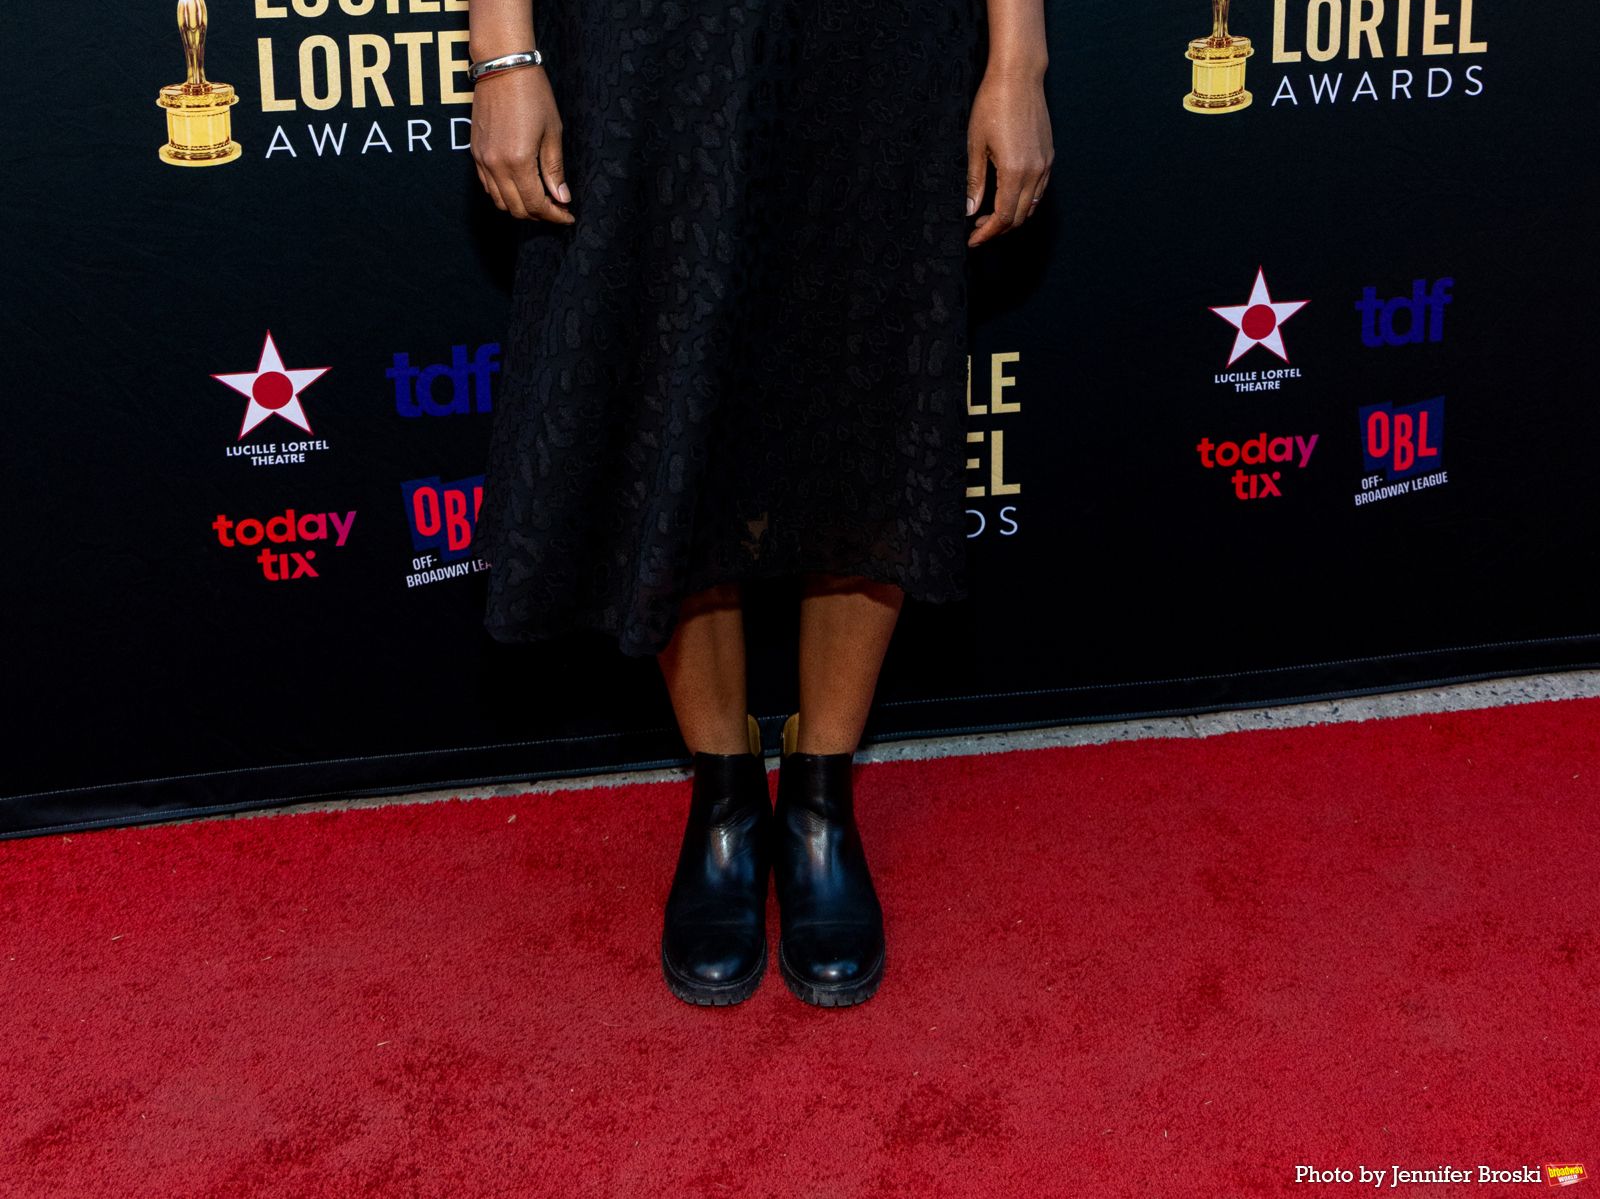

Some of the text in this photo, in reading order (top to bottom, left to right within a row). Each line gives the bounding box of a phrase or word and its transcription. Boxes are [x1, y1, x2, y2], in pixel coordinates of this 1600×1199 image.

[258, 31, 474, 111] LORTE
[1272, 66, 1482, 106] AWARDS
[265, 118, 472, 158] AWARD
[1355, 277, 1454, 347] tdf
[386, 344, 500, 417] tdf
[1214, 369, 1301, 384] LUCILLE LORTEL
[1235, 380, 1281, 393] THEATRE
[226, 440, 329, 457] LUCILLE LORTEL
[1196, 432, 1319, 468] today
[1368, 411, 1437, 470] OBL
[251, 453, 306, 466] THEATRE
[1232, 470, 1280, 499] tix
[1354, 471, 1448, 506] BROADWAY LEAGUE
[1361, 475, 1384, 490] OFF-
[212, 509, 357, 547] today
[258, 549, 318, 580] tix
[405, 561, 470, 588] BROADWAY
[412, 554, 438, 571] OFF-
